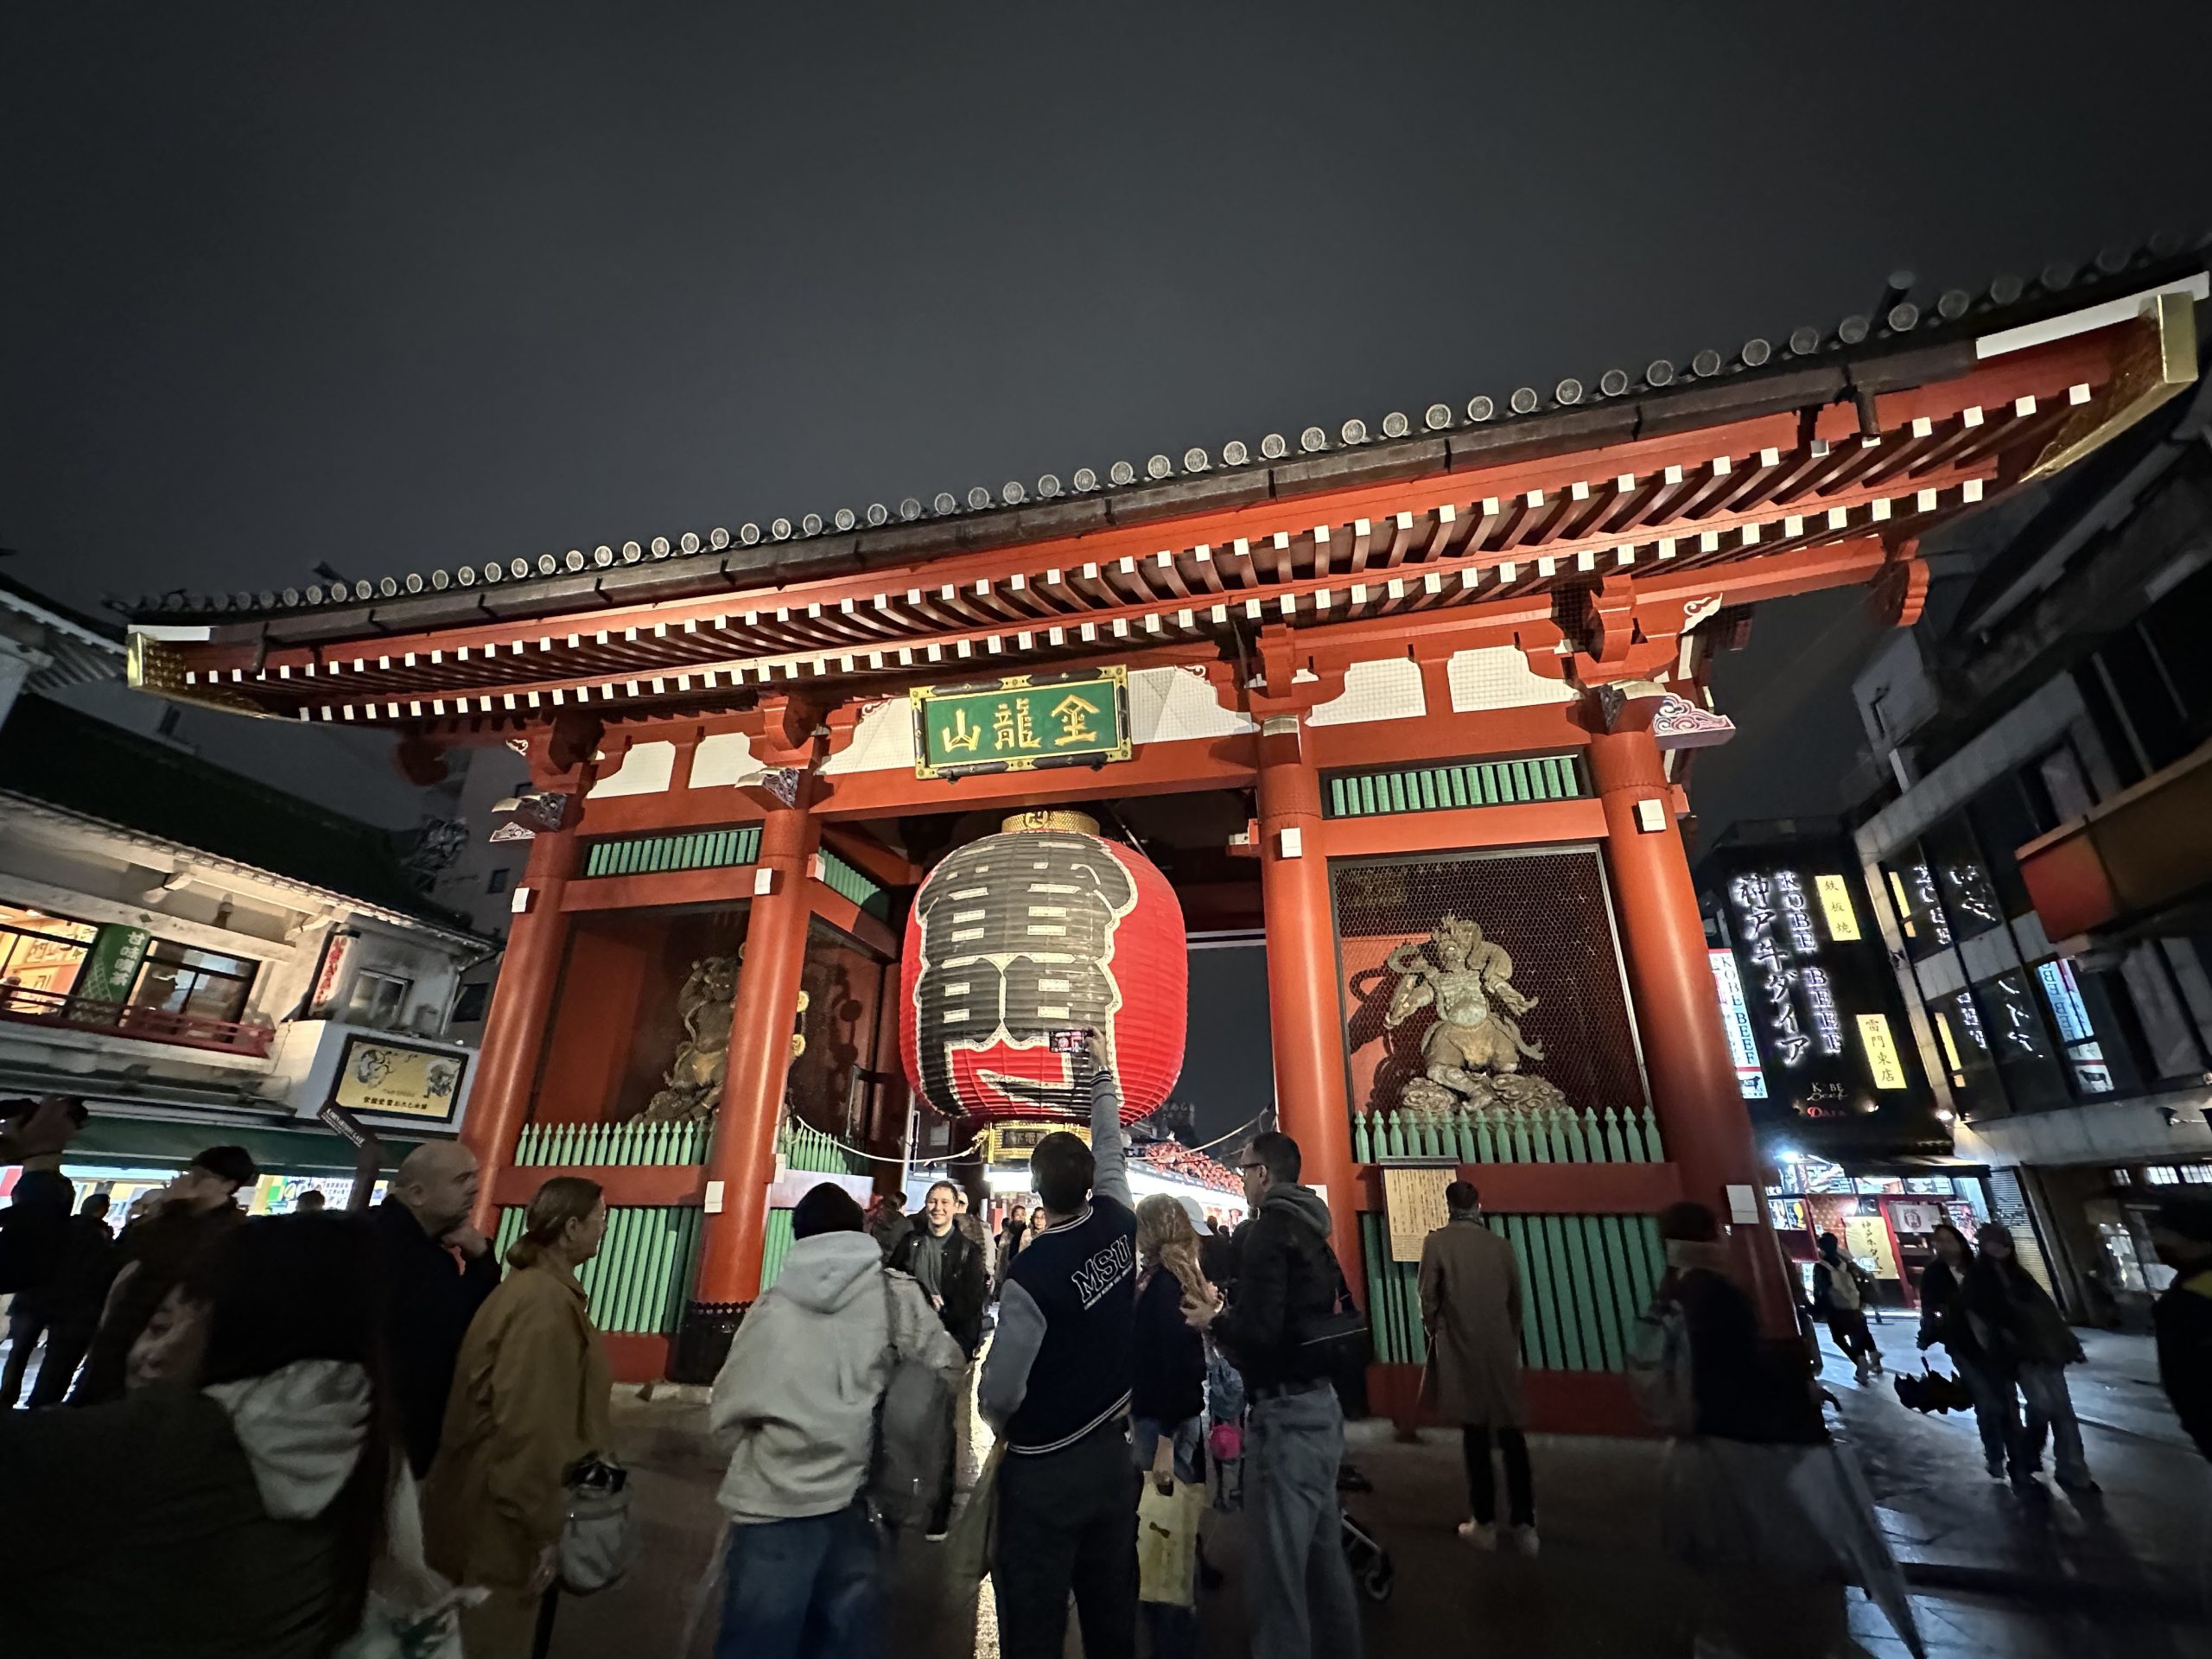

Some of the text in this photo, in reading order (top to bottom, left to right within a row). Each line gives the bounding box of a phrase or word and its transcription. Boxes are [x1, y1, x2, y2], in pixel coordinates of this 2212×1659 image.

[1824, 880, 1852, 934] 鉄板焼
[1737, 873, 1811, 1066] 神戸牛ダイア
[1778, 872, 1842, 1054] KOBE BEEF
[1721, 956, 1743, 1006] KOBE
[1736, 1012, 1756, 1065] BEEF
[1865, 1019, 1896, 1083] 雷門東店
[1811, 1082, 1844, 1092] KBE
[1071, 1235, 1132, 1303] MSU
